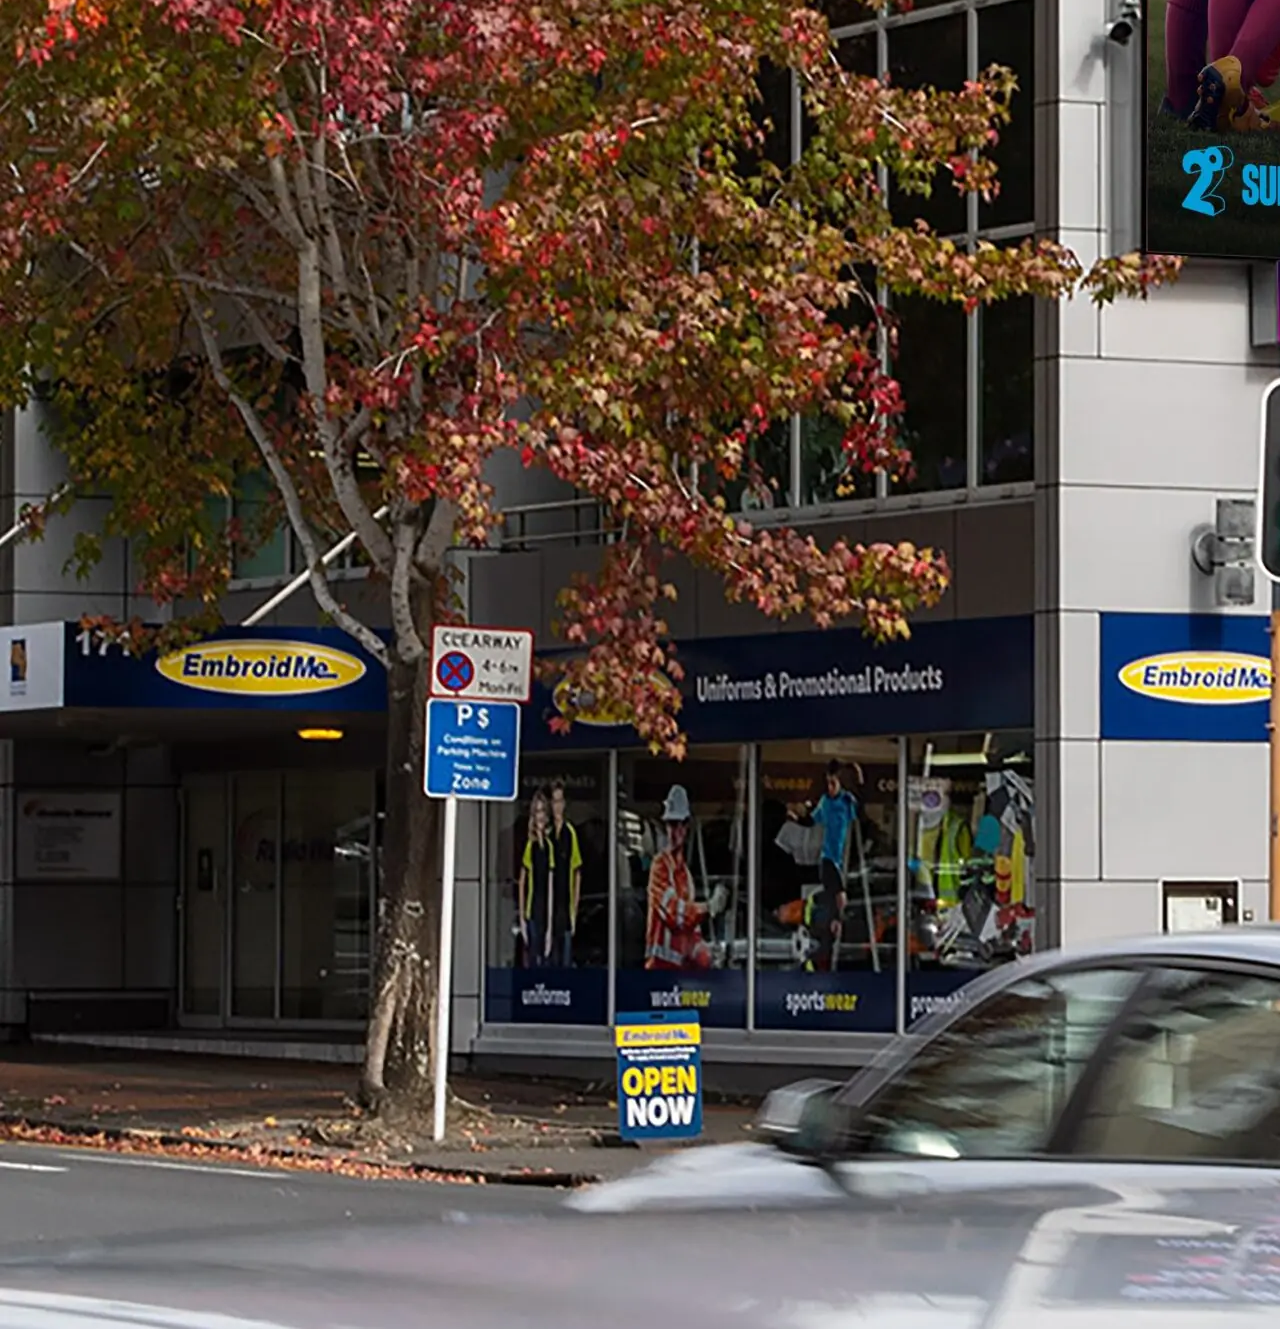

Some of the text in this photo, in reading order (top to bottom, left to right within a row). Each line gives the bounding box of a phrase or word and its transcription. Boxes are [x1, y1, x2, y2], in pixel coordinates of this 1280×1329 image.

[441, 631, 523, 650] CLEARWAY
[182, 653, 339, 679] EmbroidMe
[1142, 665, 1273, 689] EmbroidMe
[697, 662, 944, 703] Uniforms & Promotional Products
[456, 703, 473, 727] P
[436, 745, 470, 759] Parking
[452, 773, 492, 791] Zone
[521, 984, 571, 1006] uniforms
[650, 988, 712, 1008] workwear
[785, 990, 858, 1014] sportswear
[621, 1065, 698, 1097] OPEN
[626, 1096, 696, 1128] NOW
